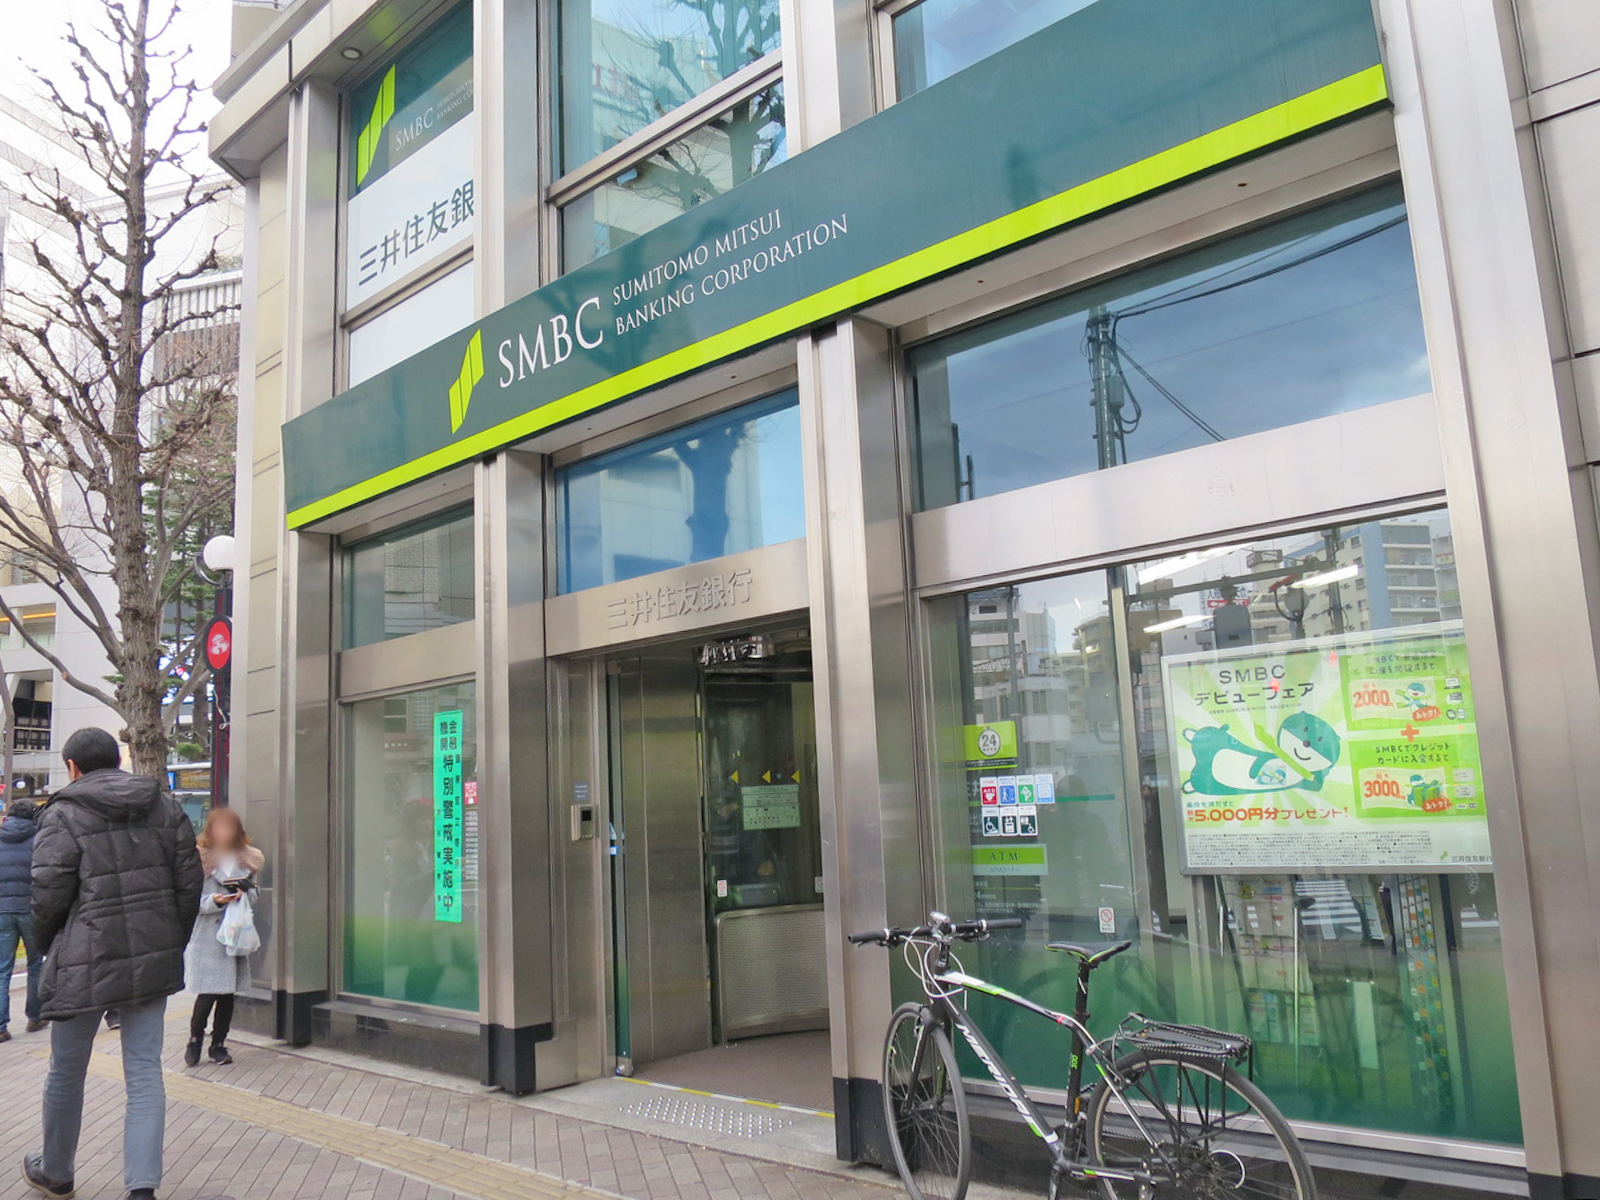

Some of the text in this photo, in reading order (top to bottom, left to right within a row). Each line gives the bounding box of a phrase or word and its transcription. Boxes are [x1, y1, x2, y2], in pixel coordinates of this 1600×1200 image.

[395, 107, 435, 151] SMBC
[358, 181, 474, 286] 三井住友銀
[612, 208, 783, 305] SUMITOMO MITSUI
[615, 213, 849, 336] BANKING CORPORATION
[498, 296, 604, 389] SMBC
[607, 569, 753, 631] 三井住友銀行
[1195, 682, 1315, 707] デビューフェア
[1219, 665, 1286, 684] SMBC
[982, 734, 997, 747] 24
[1375, 742, 1451, 754] SMBCでクレジット
[1377, 753, 1449, 765] カードに入会すると
[990, 851, 1018, 862] ATM
[955, 1023, 1030, 1116] MERIDA
